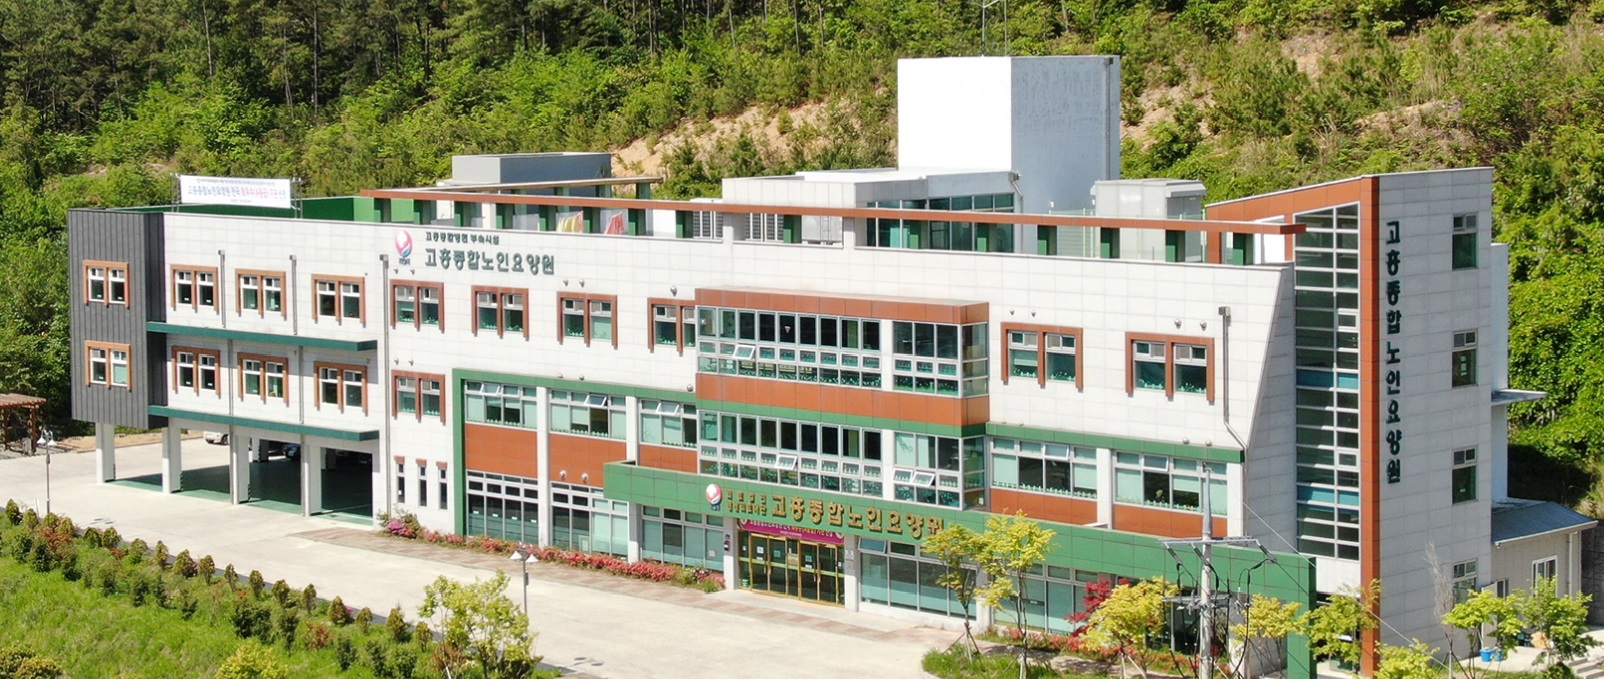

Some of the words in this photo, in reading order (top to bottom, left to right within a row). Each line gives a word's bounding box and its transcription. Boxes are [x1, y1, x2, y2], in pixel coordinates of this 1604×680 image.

[425, 248, 554, 275] 고흥종합노인요양원
[1386, 221, 1402, 484] 고흥종합노인요양원
[771, 494, 944, 539] 고흥종합노인요양원
